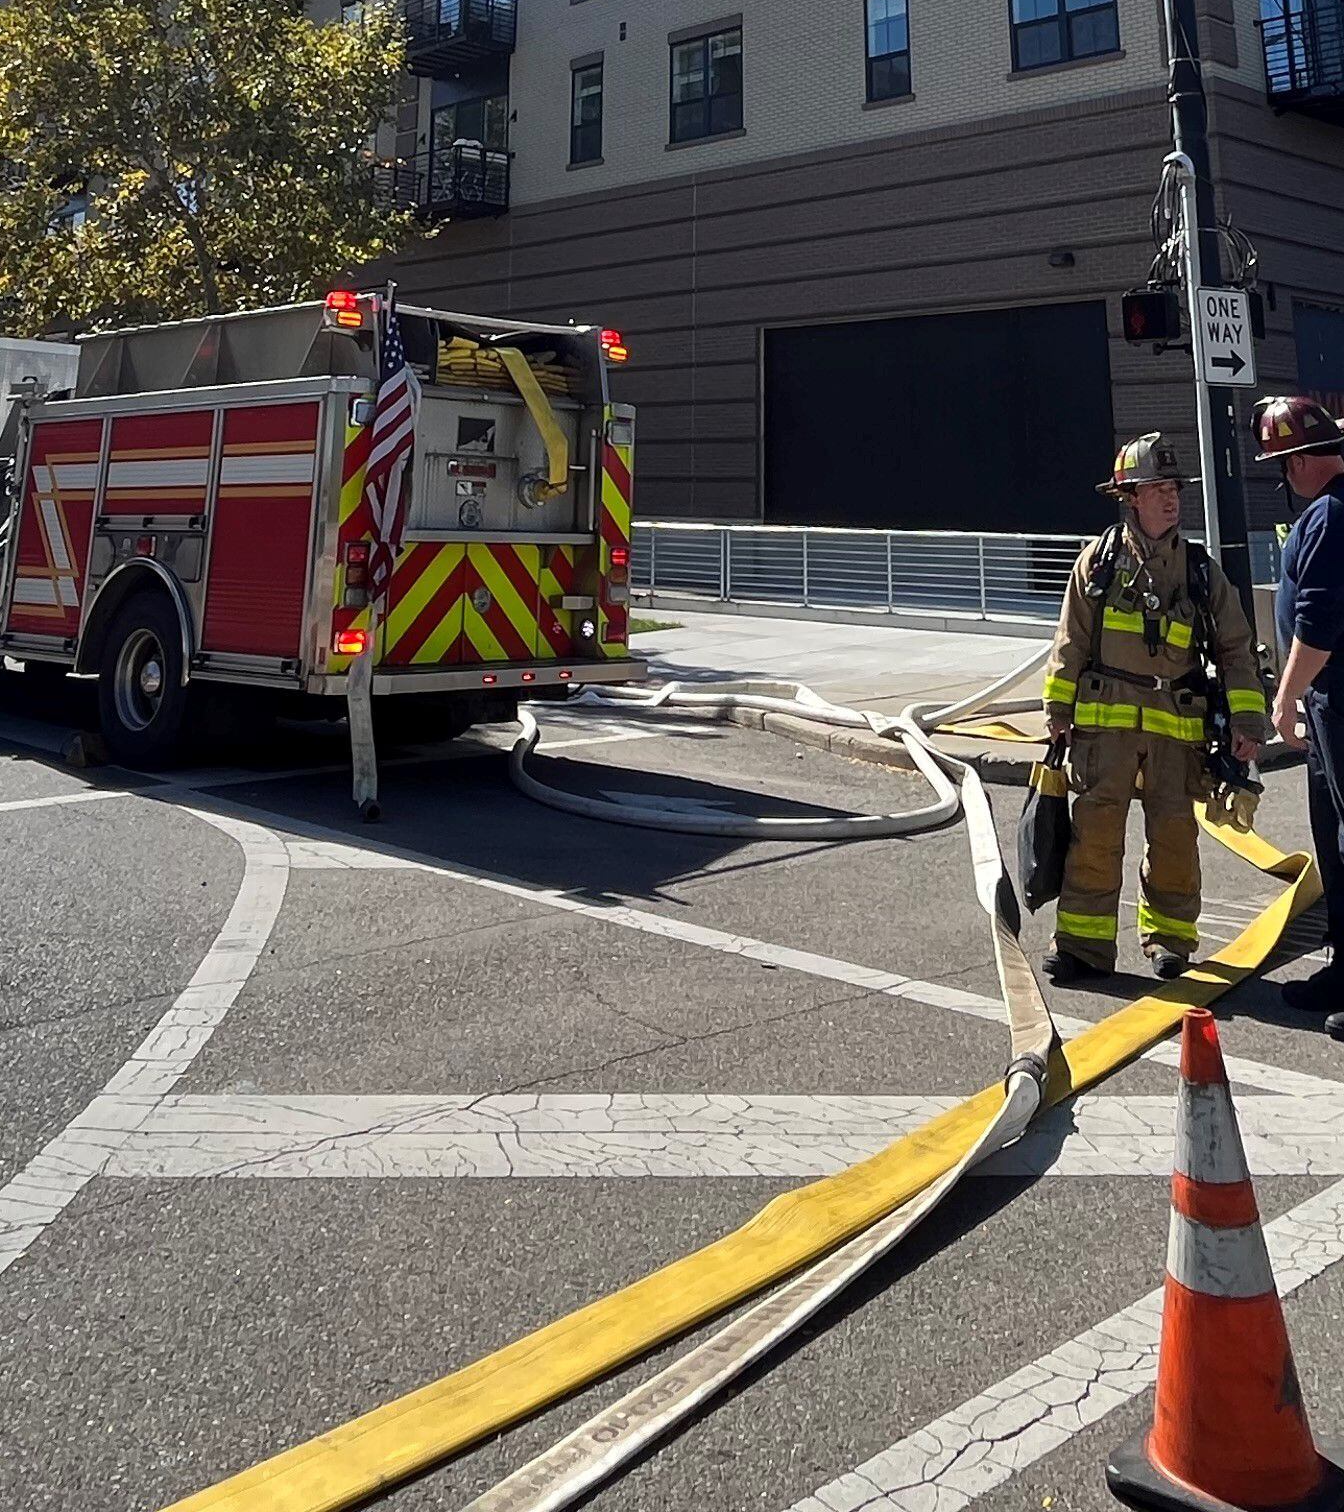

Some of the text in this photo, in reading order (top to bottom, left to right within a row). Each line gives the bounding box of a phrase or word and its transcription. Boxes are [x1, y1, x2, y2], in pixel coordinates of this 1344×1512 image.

[1207, 297, 1241, 319] ONE
[1207, 322, 1243, 345] WAY
[591, 1376, 687, 1443] ECO-10
